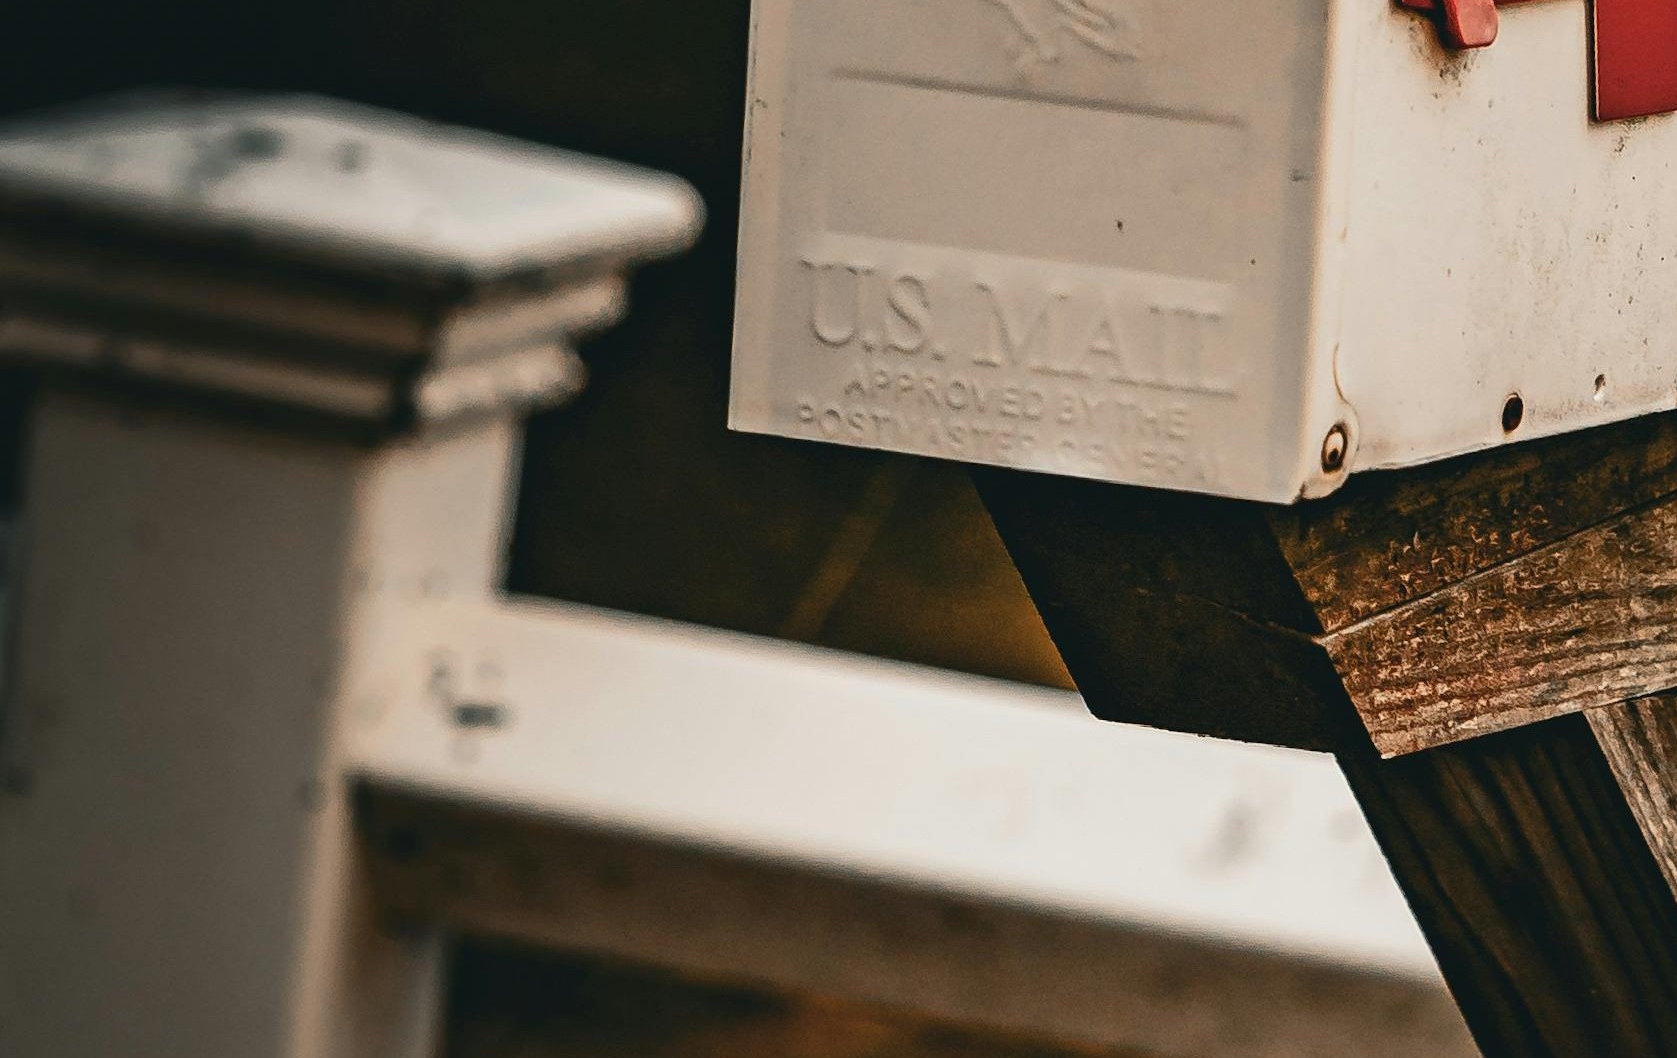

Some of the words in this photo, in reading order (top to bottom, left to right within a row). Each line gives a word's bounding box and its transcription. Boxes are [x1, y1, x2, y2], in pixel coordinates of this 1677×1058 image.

[799, 256, 946, 362] U.S.
[971, 280, 1238, 400] MAIL
[842, 366, 1043, 422] APPROVED
[1056, 388, 1104, 428] BY
[1111, 397, 1188, 442] THE
